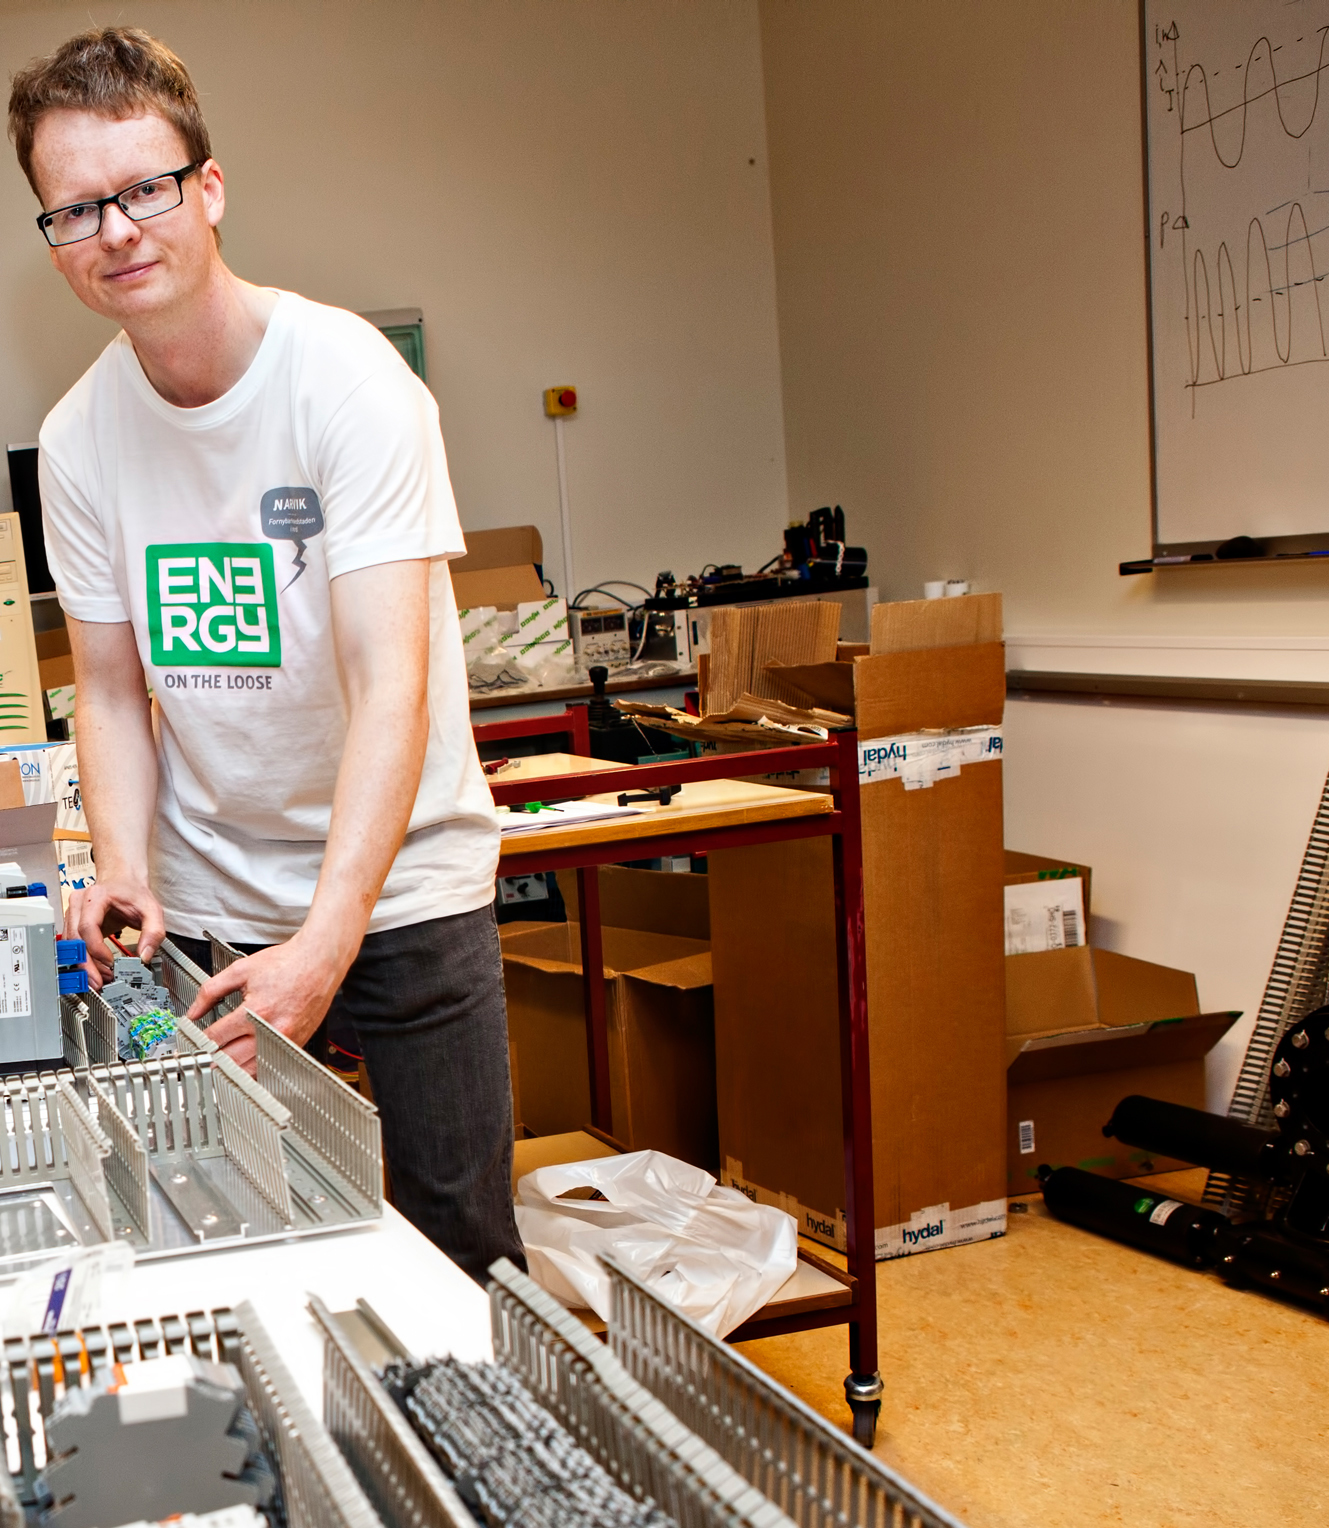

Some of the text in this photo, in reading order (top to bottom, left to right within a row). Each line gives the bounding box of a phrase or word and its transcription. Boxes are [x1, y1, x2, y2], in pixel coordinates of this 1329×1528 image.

[164, 674, 272, 690] ON THE LOOSE
[863, 742, 907, 767] hydal
[806, 1212, 835, 1238] hydal
[902, 1219, 944, 1245] hydal
